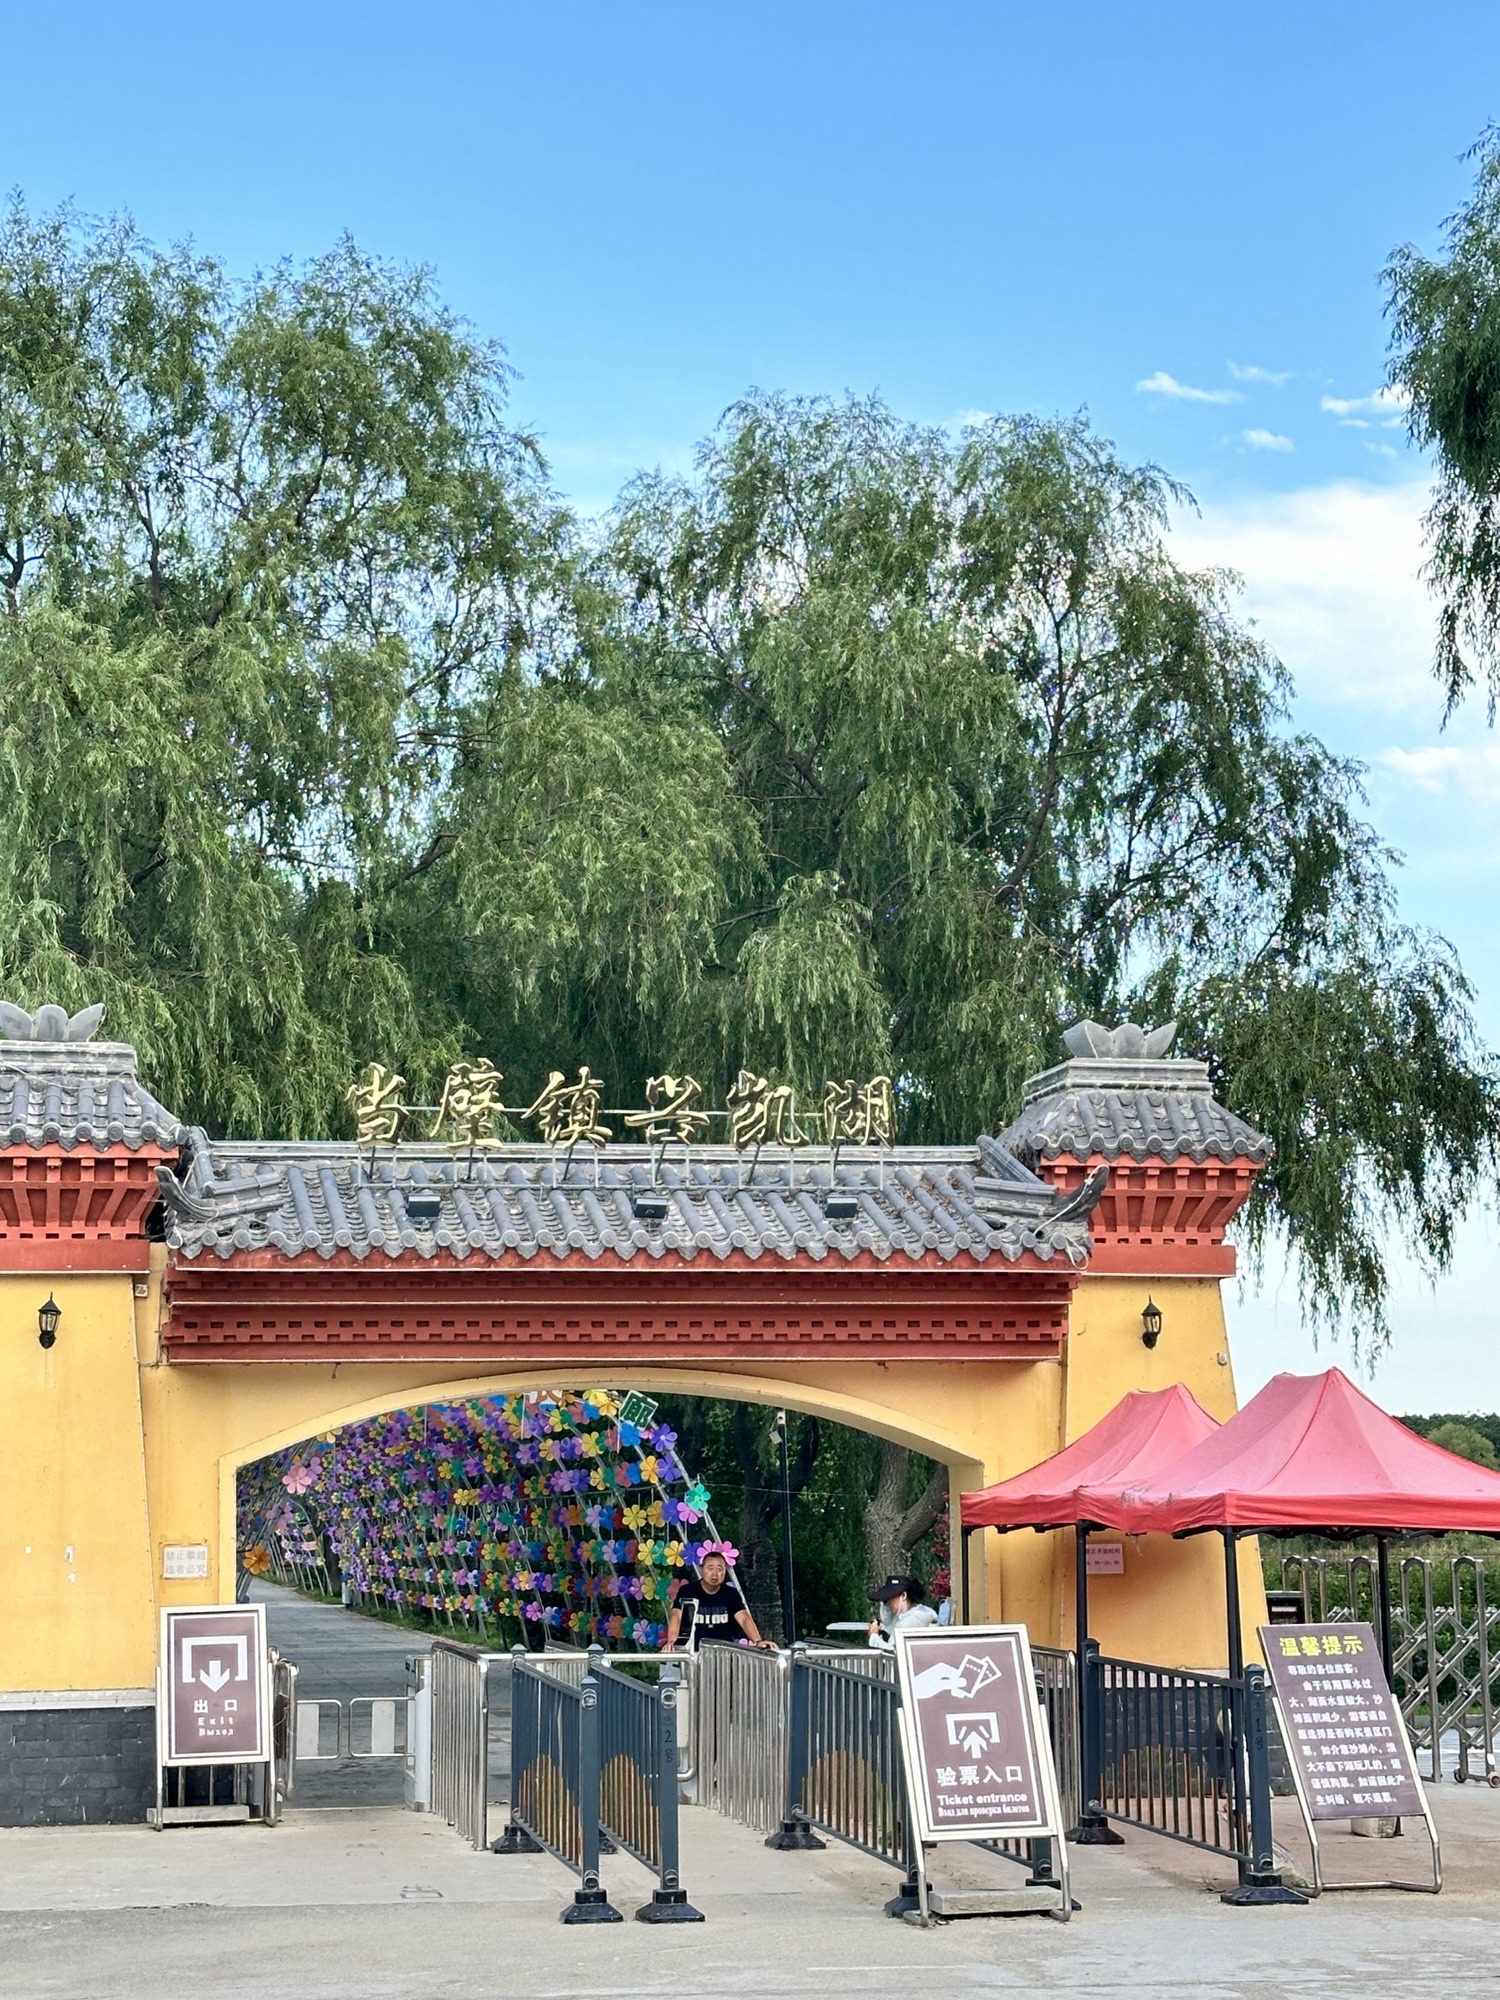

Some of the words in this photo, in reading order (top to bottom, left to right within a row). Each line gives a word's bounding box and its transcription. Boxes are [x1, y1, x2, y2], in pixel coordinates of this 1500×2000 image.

[1279, 1634, 1364, 1657] 温馨提示
[193, 1698, 238, 1713] 出口
[198, 1716, 234, 1726] Exit
[936, 1765, 1023, 1787] 验票入口
[937, 1794, 974, 1806] Ticket
[976, 1793, 1028, 1804] entrance
